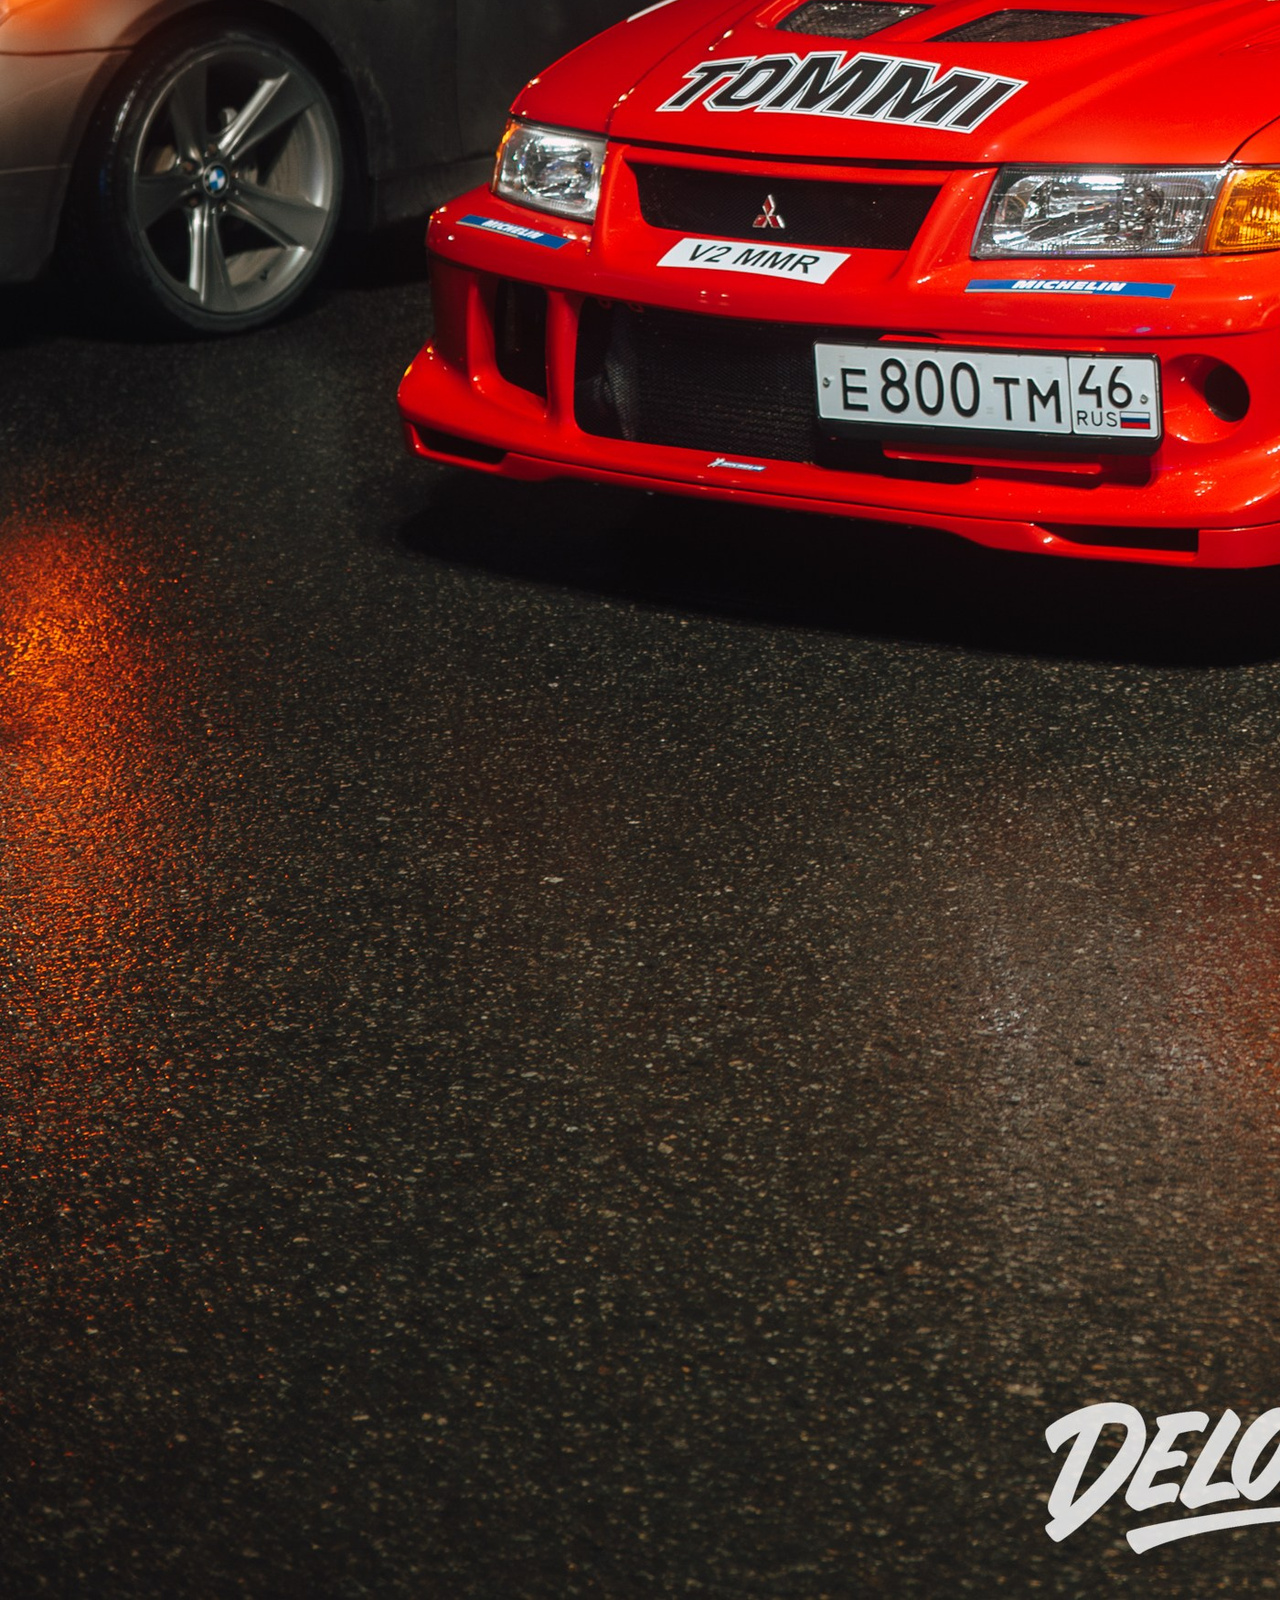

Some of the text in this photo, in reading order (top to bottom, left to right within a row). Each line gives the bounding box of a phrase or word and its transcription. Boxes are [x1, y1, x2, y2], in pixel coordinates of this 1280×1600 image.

[656, 52, 1027, 133] TOMMI
[481, 219, 544, 240] MICHELIN
[688, 244, 821, 275] V2 MMR
[1012, 279, 1127, 292] MICHELIN
[1079, 364, 1133, 410] 46
[1077, 409, 1118, 428] RUS
